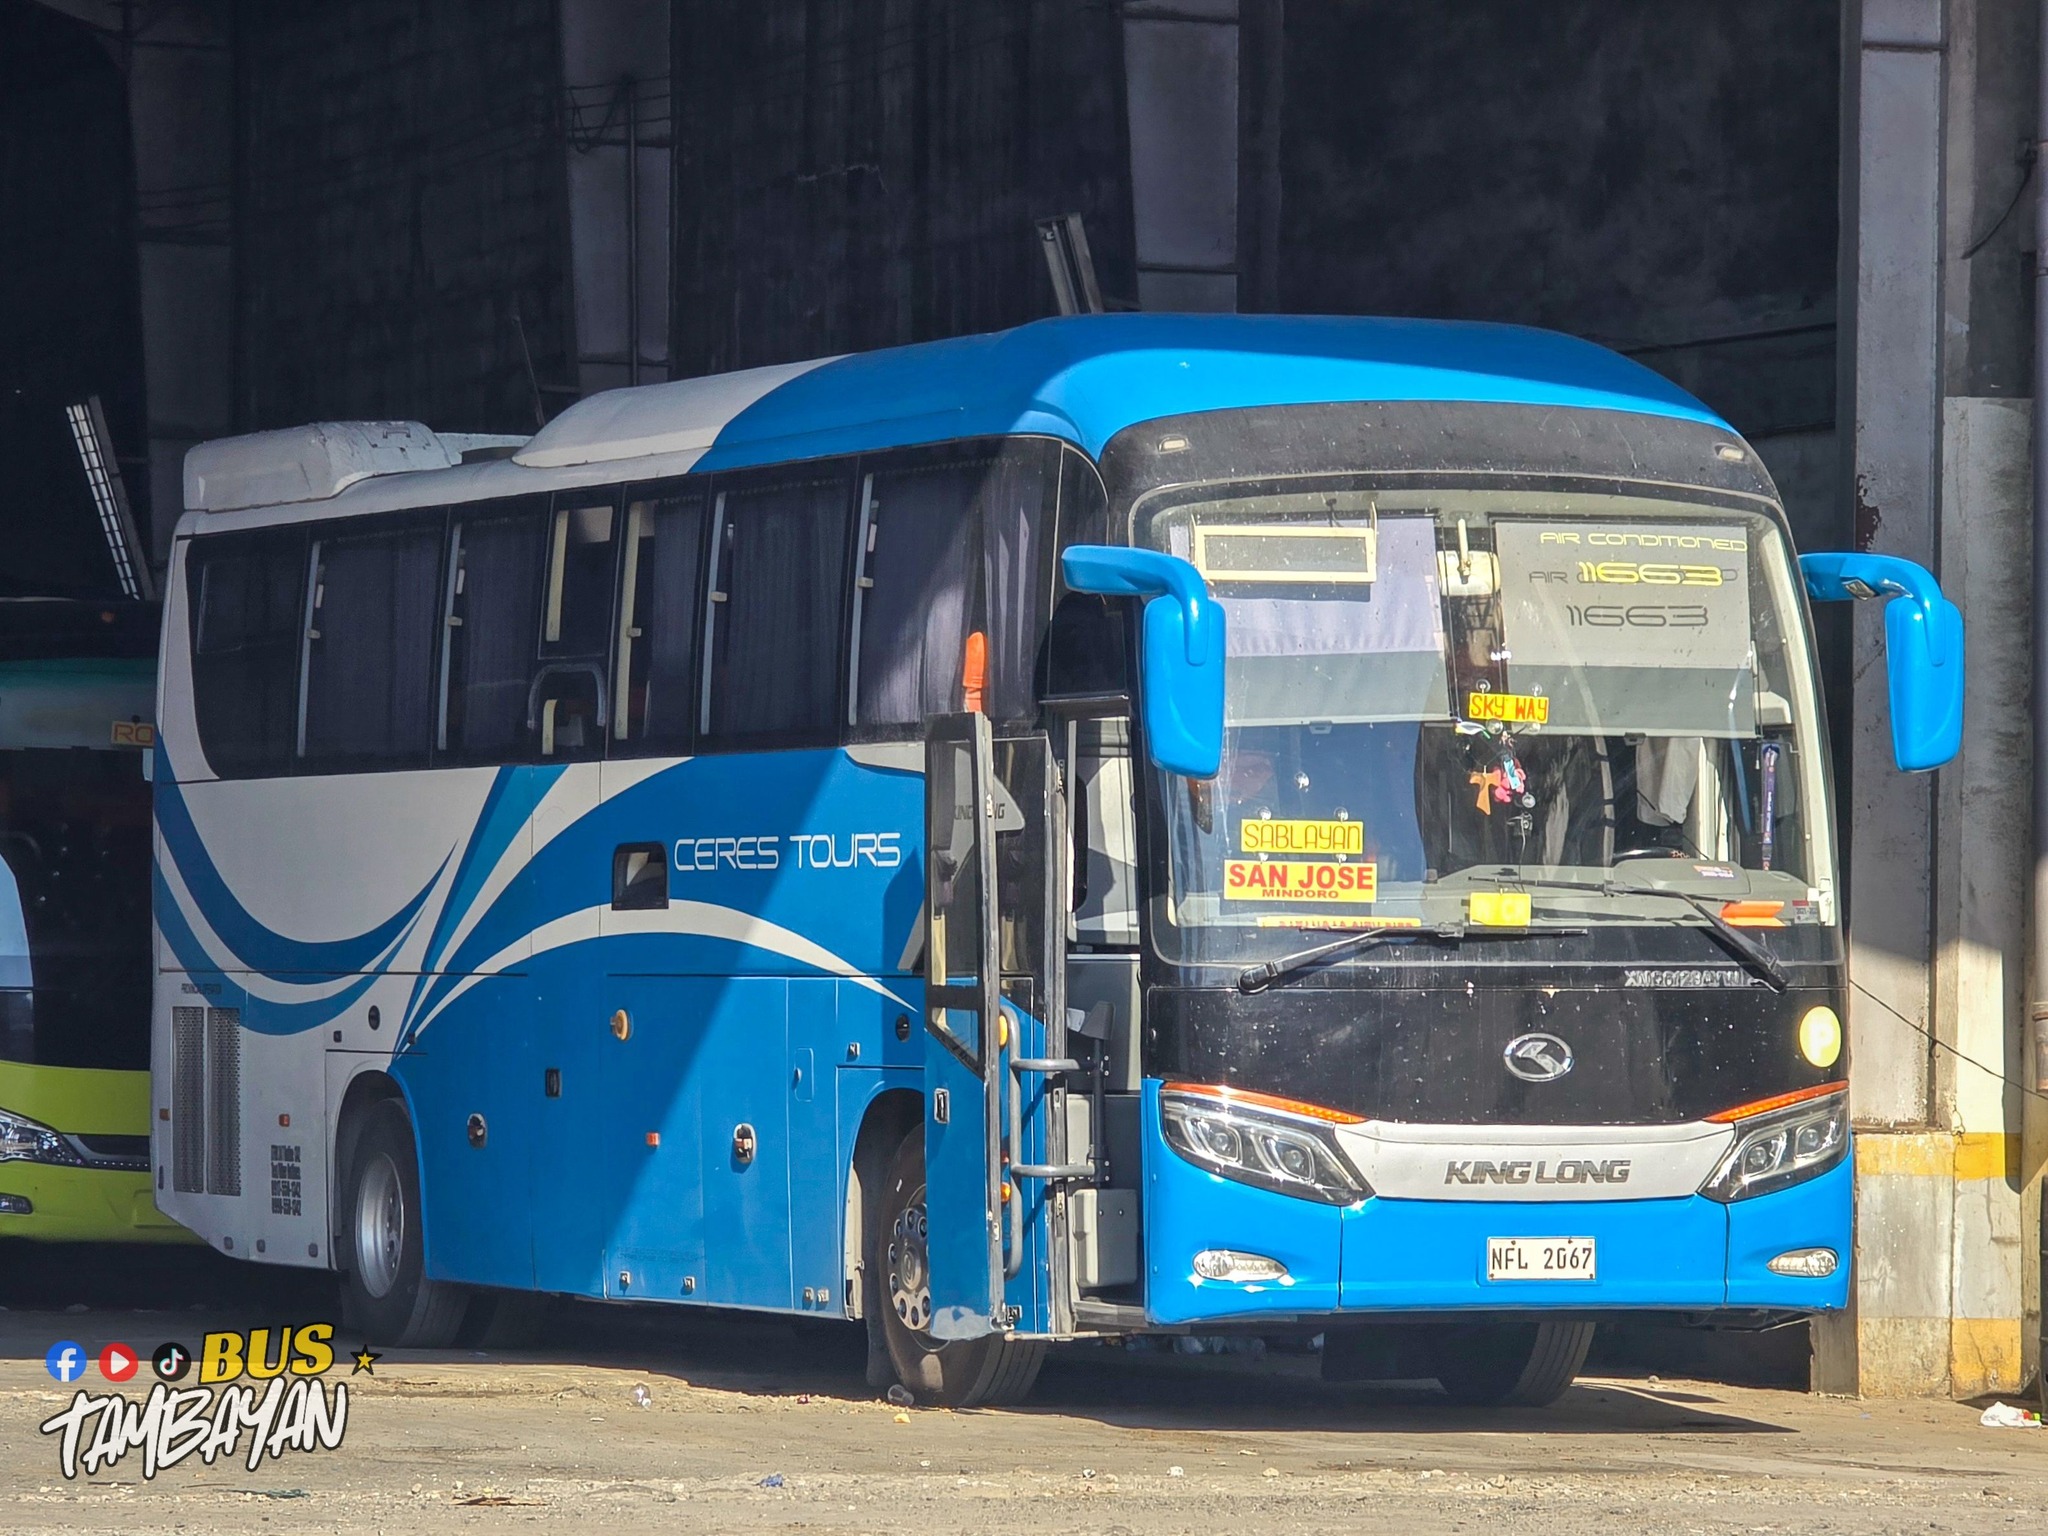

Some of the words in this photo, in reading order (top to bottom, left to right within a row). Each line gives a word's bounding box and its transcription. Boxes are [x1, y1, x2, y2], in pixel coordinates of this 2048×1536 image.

[1540, 532, 1580, 544] AIR
[1588, 533, 1748, 551] CONDITIONED
[1578, 561, 1723, 586] 11663
[1565, 605, 1709, 627] 11663
[1471, 694, 1505, 718] SKY
[1515, 697, 1548, 721] WAY
[1244, 823, 1361, 850] SABLAYAN
[674, 836, 779, 871] CERES
[789, 832, 901, 869] TOURS
[1229, 864, 1288, 888] SAN
[1298, 865, 1374, 890] JOSE
[1262, 889, 1339, 899] MINDORO
[1444, 1161, 1532, 1184] KING
[1535, 1160, 1631, 1184] LONG
[1491, 1247, 1528, 1270] NFL
